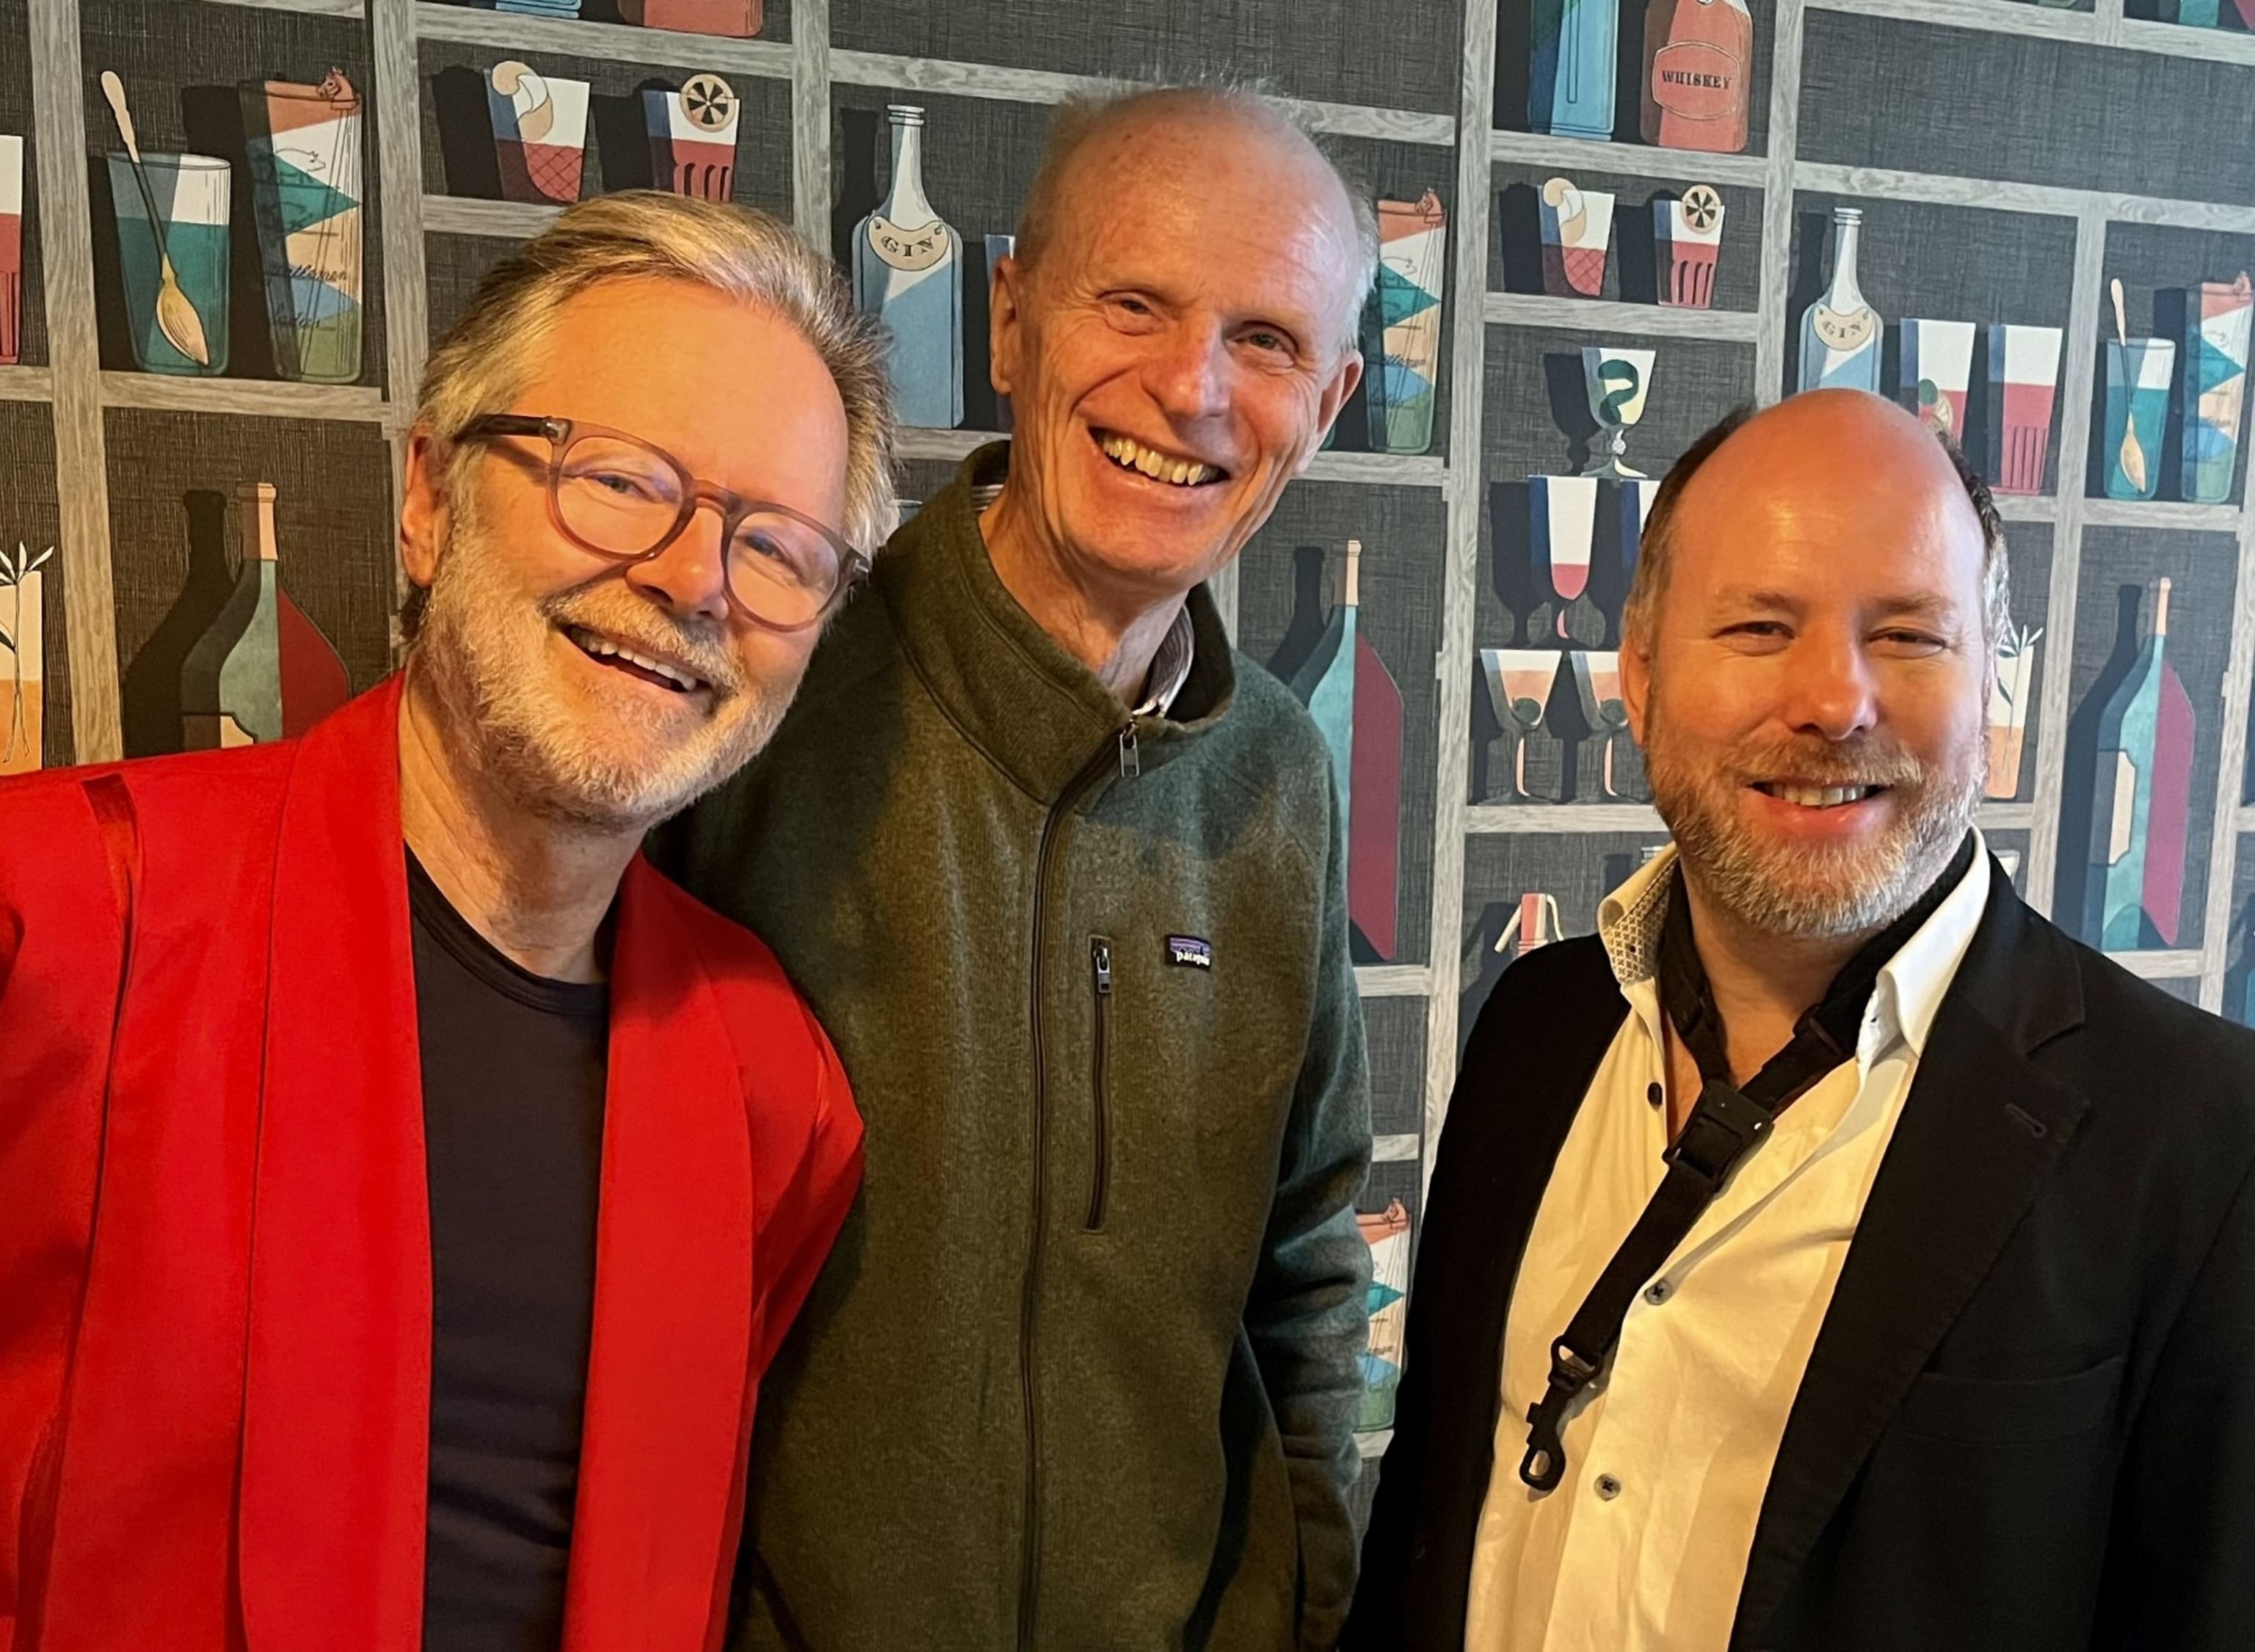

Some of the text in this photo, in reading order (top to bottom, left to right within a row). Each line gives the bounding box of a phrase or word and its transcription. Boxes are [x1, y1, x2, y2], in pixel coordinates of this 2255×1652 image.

[1661, 70, 1732, 89] WHISKEY
[881, 236, 934, 257] GIN
[1822, 321, 1862, 338] GIN
